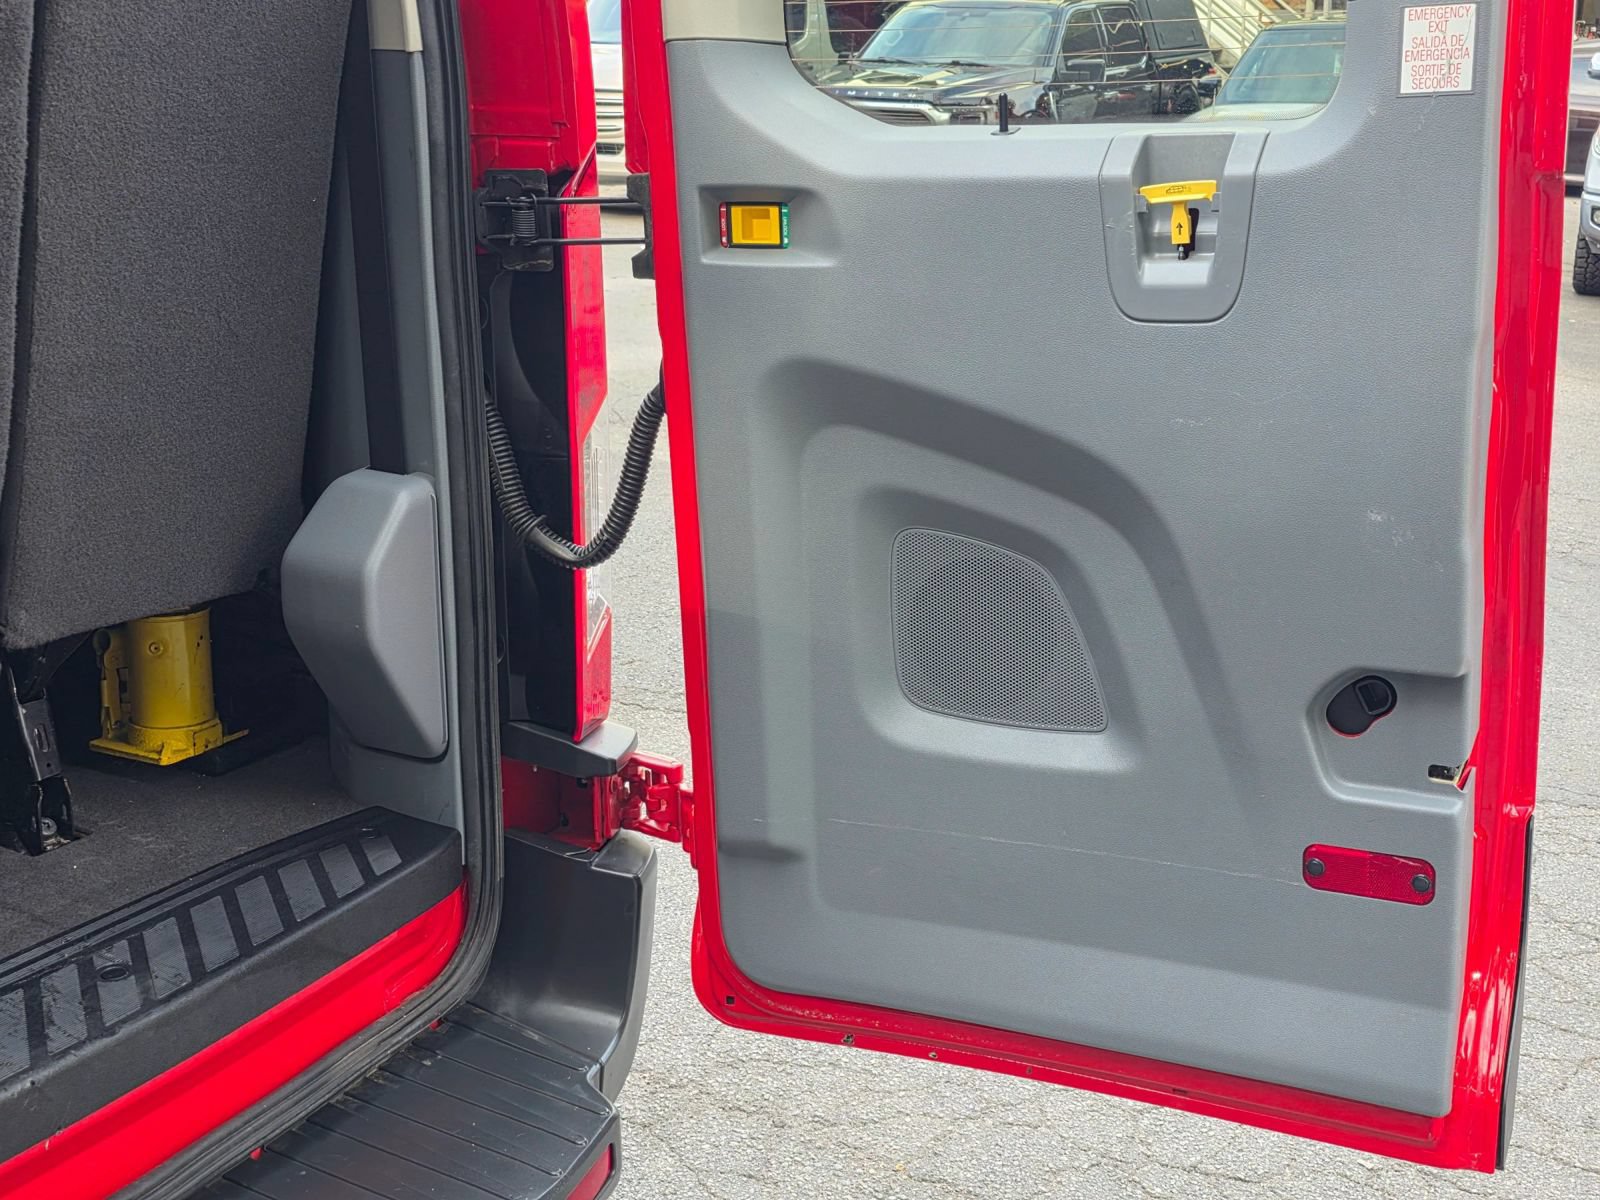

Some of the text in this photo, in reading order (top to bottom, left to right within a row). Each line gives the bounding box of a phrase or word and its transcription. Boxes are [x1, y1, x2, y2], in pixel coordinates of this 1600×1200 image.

[1408, 6, 1471, 21] EMERGENCY
[1428, 20, 1449, 33] EXIT
[1412, 34, 1464, 49] SALIDA DE
[1404, 47, 1470, 62] EMERGENCIA
[1411, 63, 1462, 77] SORTIE DE
[1412, 76, 1460, 90] SECOURS
